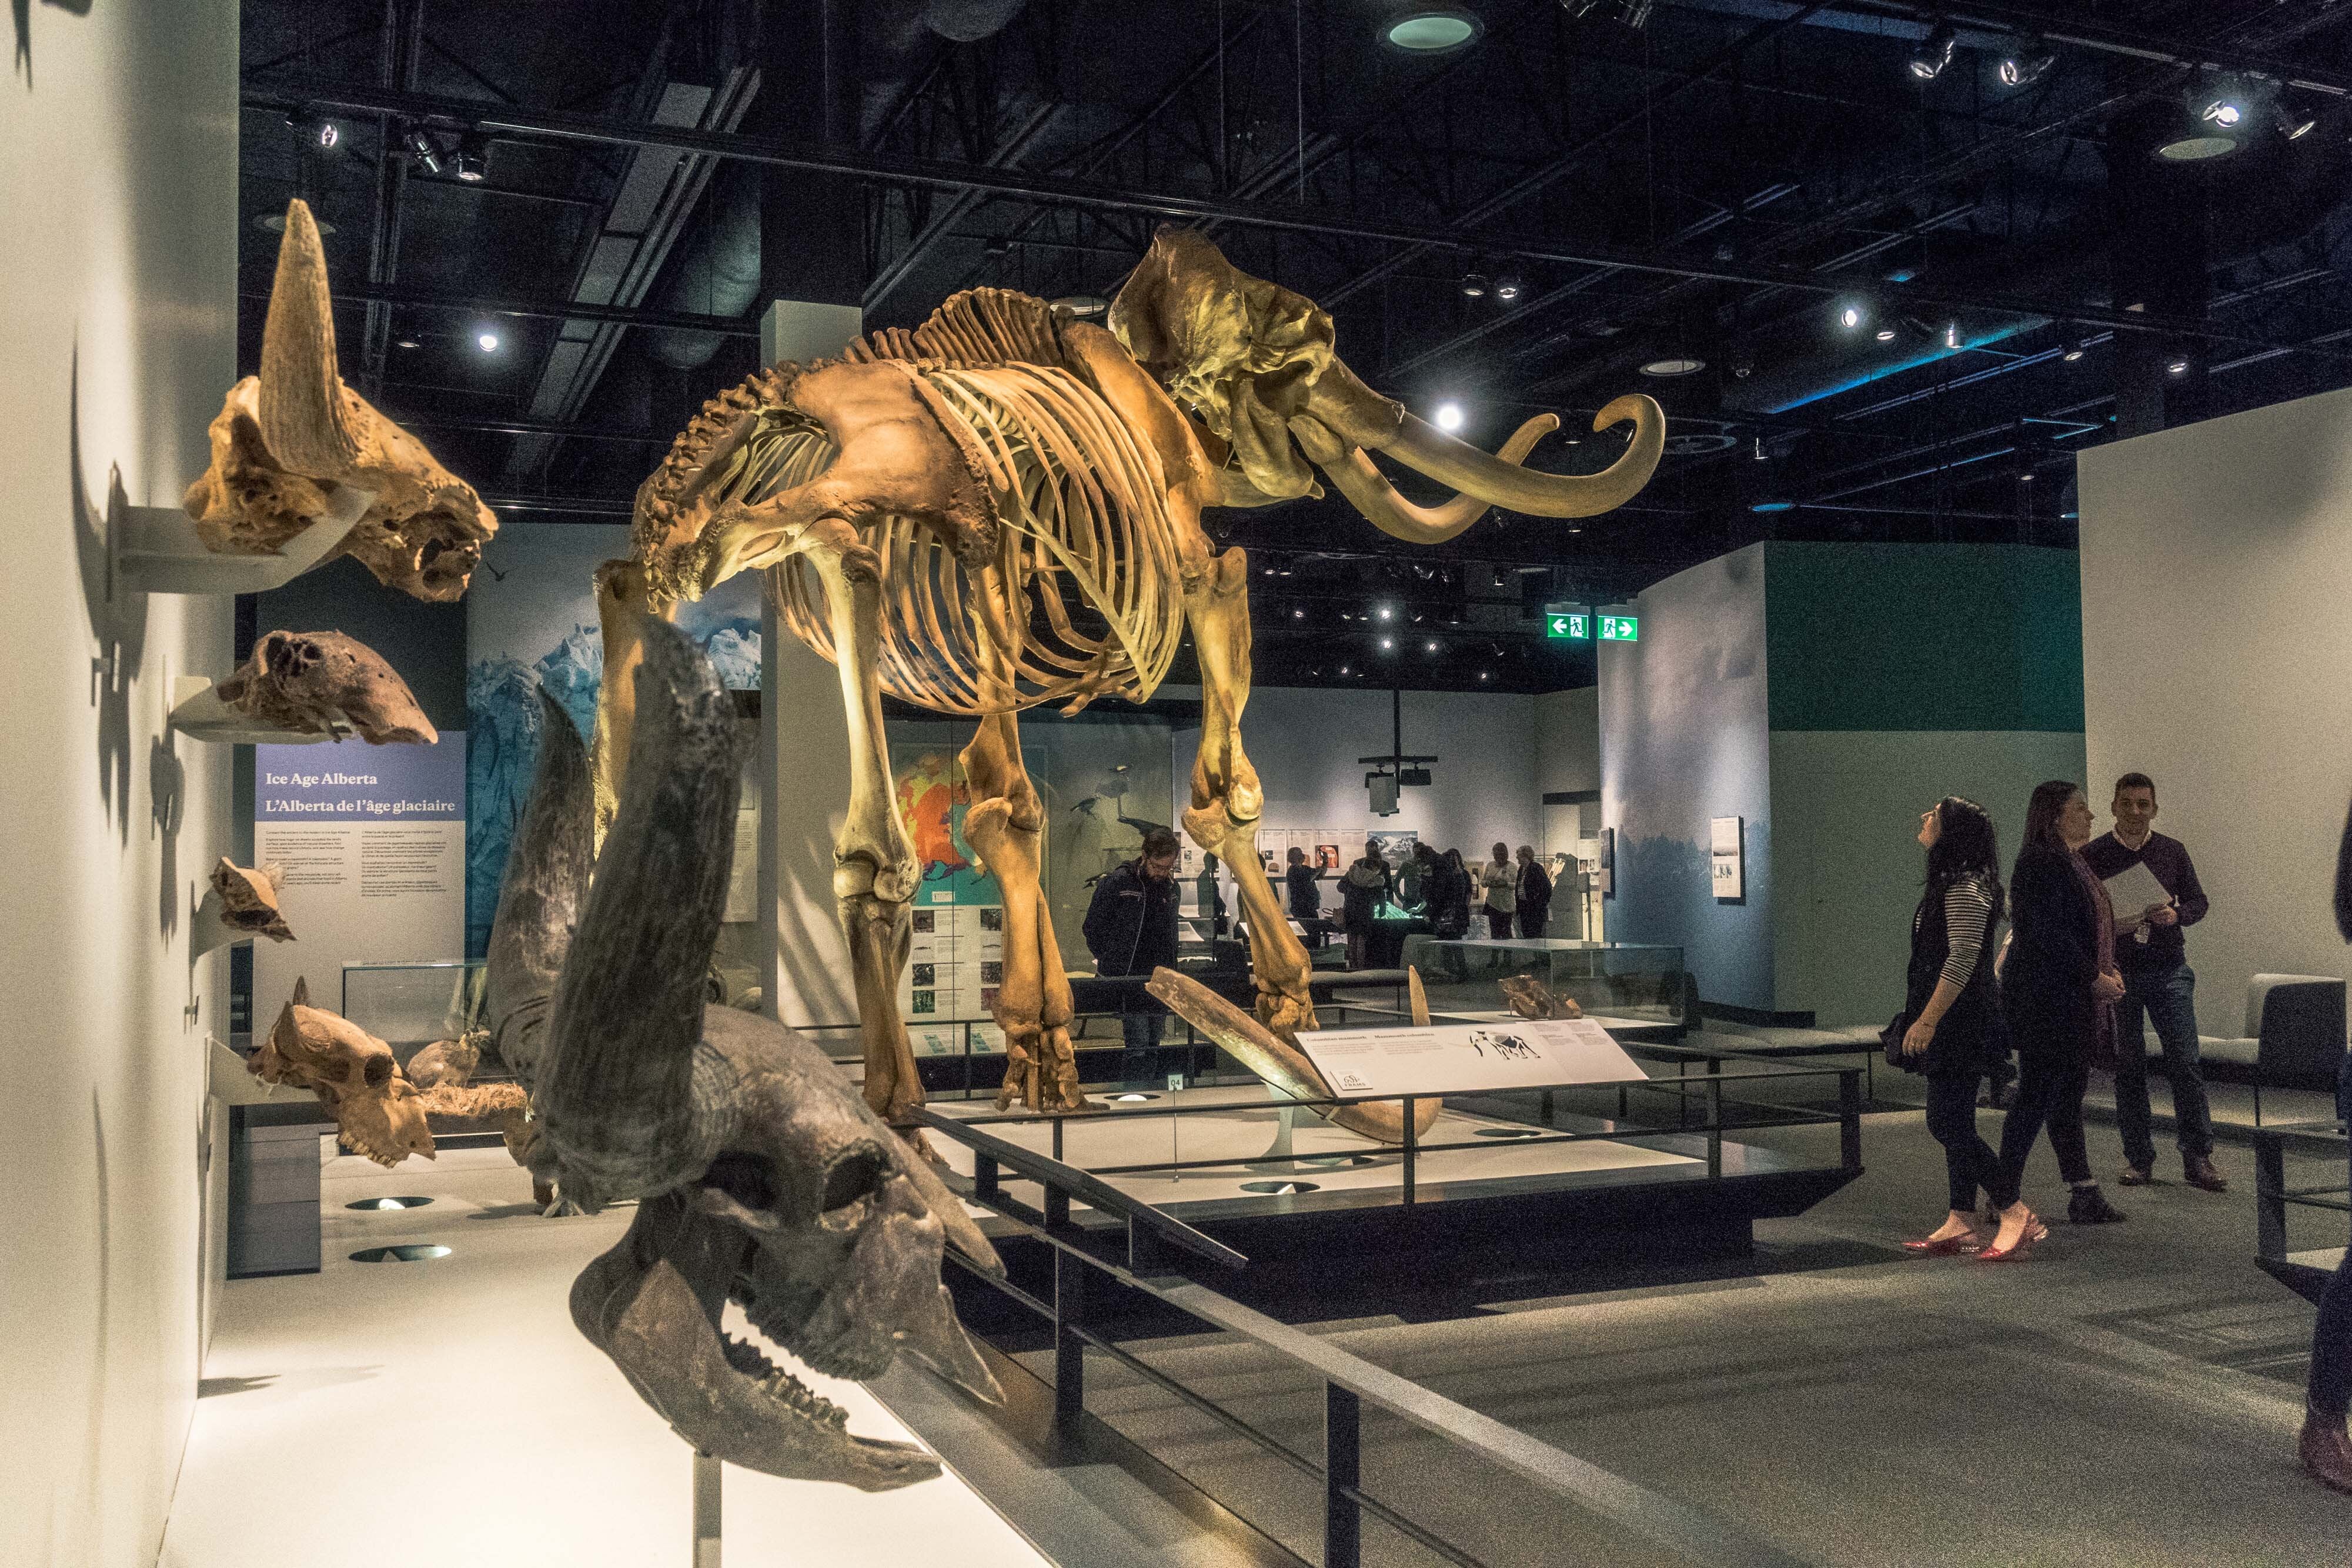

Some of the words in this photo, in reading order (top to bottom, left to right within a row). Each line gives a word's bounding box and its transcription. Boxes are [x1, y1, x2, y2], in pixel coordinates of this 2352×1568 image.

[266, 773, 288, 784] Ice
[290, 773, 319, 787] Age
[322, 773, 377, 784] Alberta
[266, 800, 334, 811] L’Alberta
[336, 800, 354, 811] de
[356, 800, 390, 814] l’âge
[393, 800, 455, 814] glaciaire
